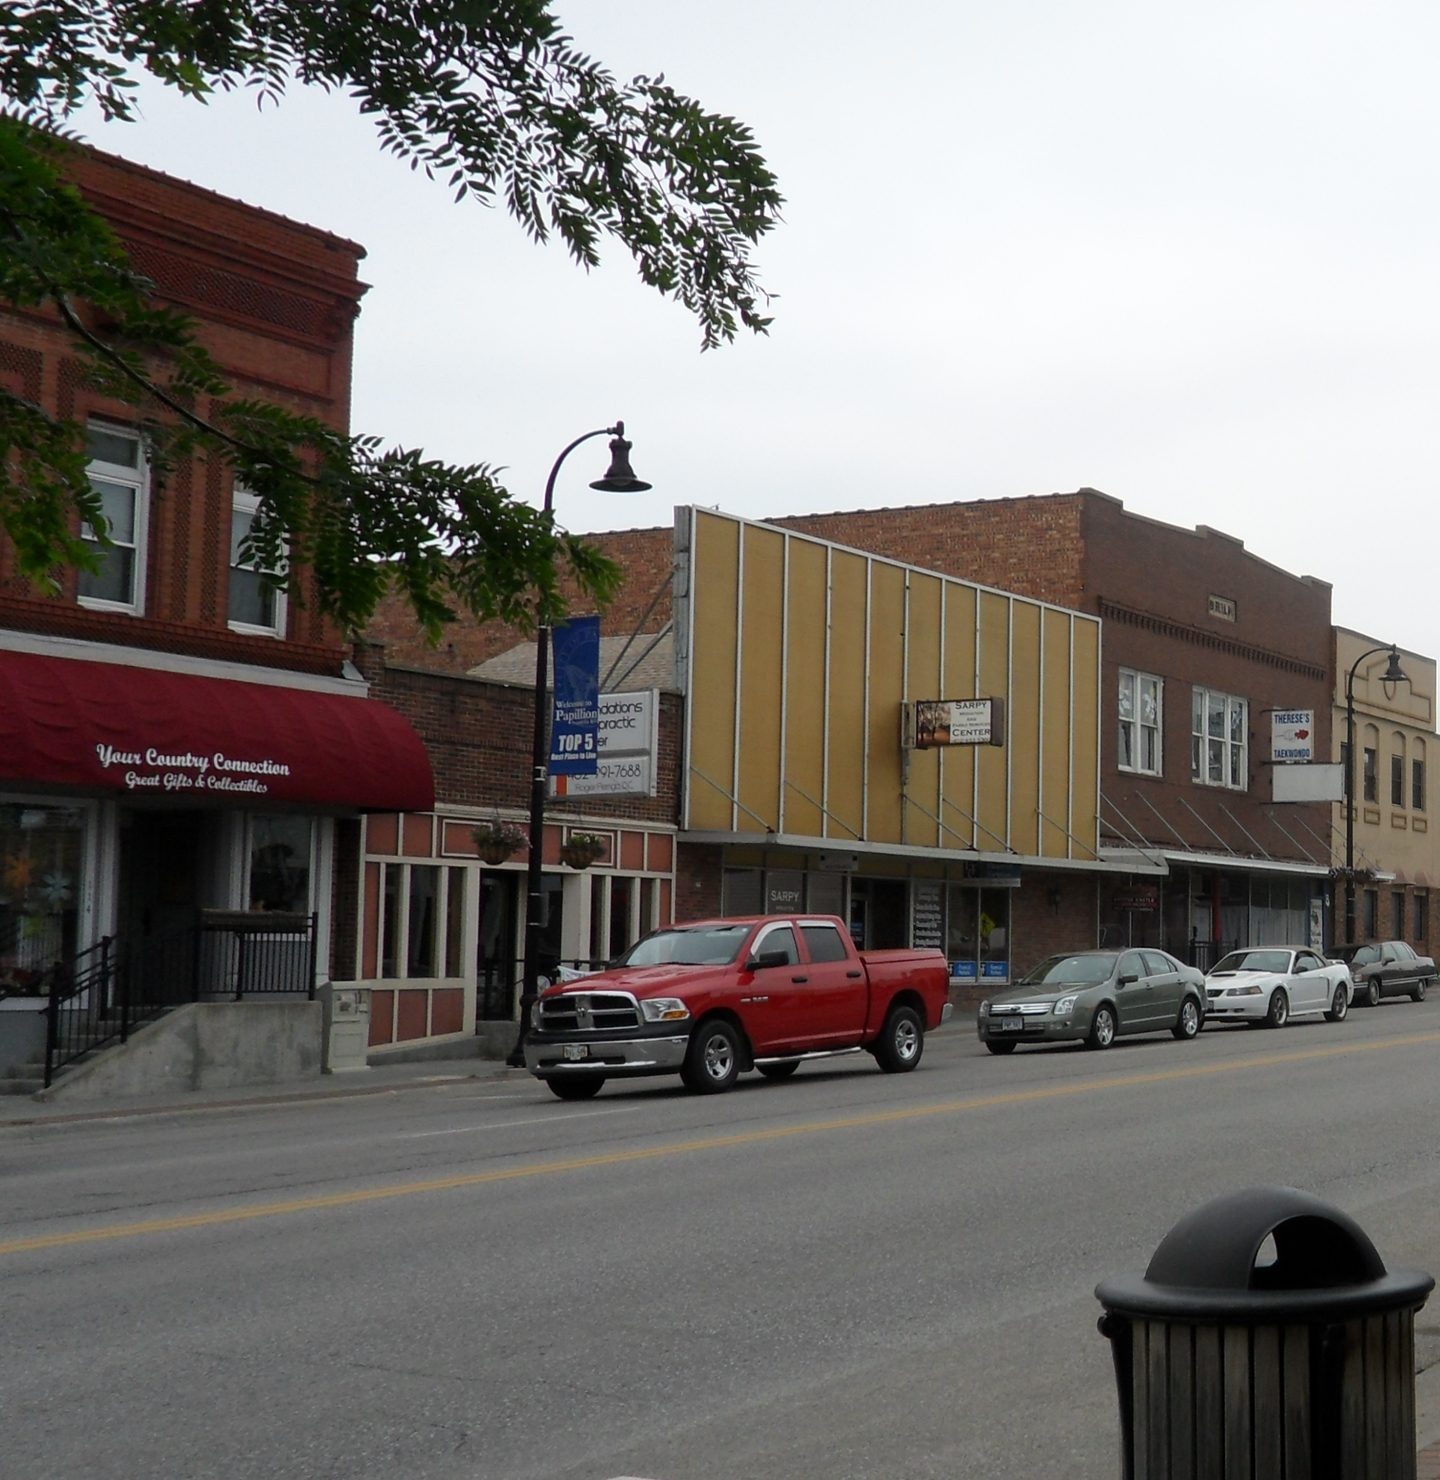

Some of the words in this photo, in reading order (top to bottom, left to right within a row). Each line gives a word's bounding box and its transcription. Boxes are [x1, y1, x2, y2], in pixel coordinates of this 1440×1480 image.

[556, 701, 584, 709] Welcome
[955, 701, 987, 710] SARPY
[555, 708, 599, 724] Papillion
[1274, 713, 1310, 724] THERESE'S
[952, 728, 991, 737] CENTER
[558, 735, 582, 751] TOP
[585, 733, 594, 750] 5
[1274, 748, 1310, 759] TAEKWONDO
[96, 743, 142, 768] Your
[145, 747, 210, 773] Country
[213, 752, 290, 776] Connection
[125, 771, 160, 789] Great
[163, 772, 193, 790] Gifts
[194, 774, 205, 788] &
[207, 774, 268, 793] Collectibles
[770, 890, 799, 902] SARPY
